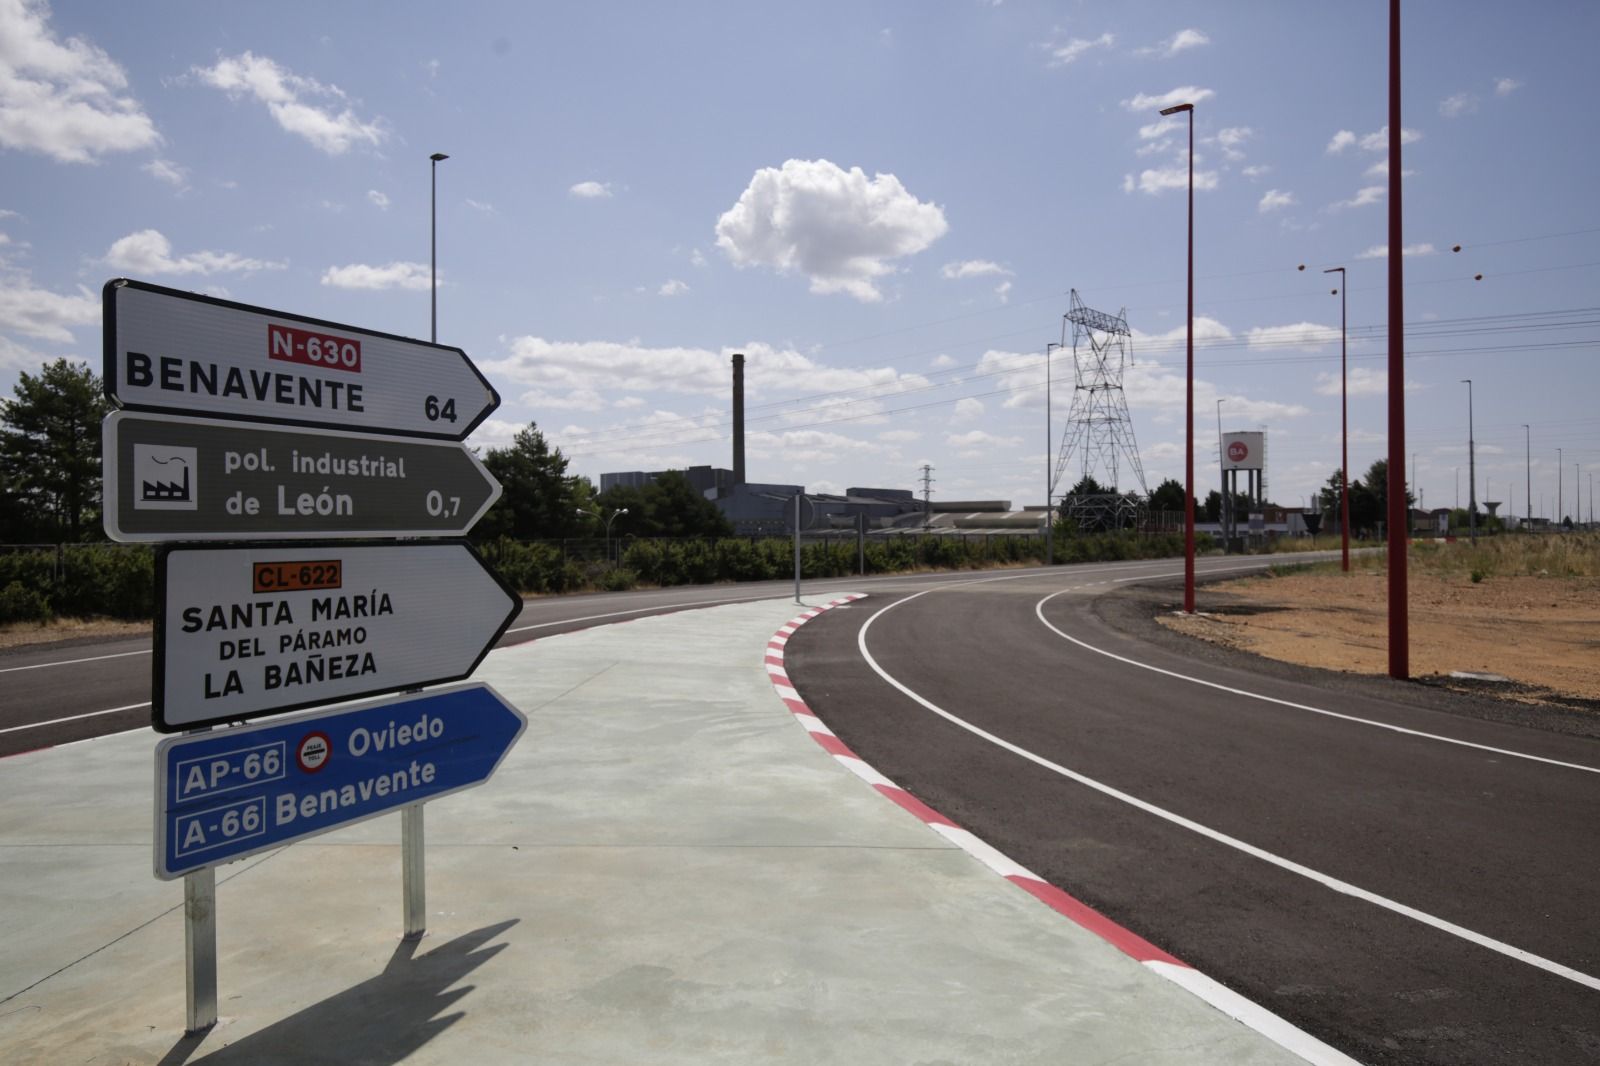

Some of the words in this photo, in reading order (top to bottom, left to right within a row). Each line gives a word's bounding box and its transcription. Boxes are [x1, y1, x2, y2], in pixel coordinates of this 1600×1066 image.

[273, 330, 357, 368] N-630
[126, 352, 365, 413] BENAVENTE
[424, 395, 458, 424] 64
[225, 448, 275, 475] pol.
[292, 450, 406, 479] industrial
[226, 491, 260, 516] de
[278, 485, 353, 516] León
[426, 490, 461, 519] 0,7
[257, 565, 338, 587] CL-622
[181, 601, 293, 633] SANTA
[312, 589, 393, 621] MARÍA
[220, 637, 265, 661] DEL
[279, 626, 367, 653] PÁRAMO
[204, 670, 243, 699] LA
[265, 652, 377, 690] BAÑEZA
[348, 714, 444, 757] Oviedo
[183, 749, 280, 794] AP-66
[276, 760, 436, 826] Benavente
[183, 805, 260, 848] A-66
